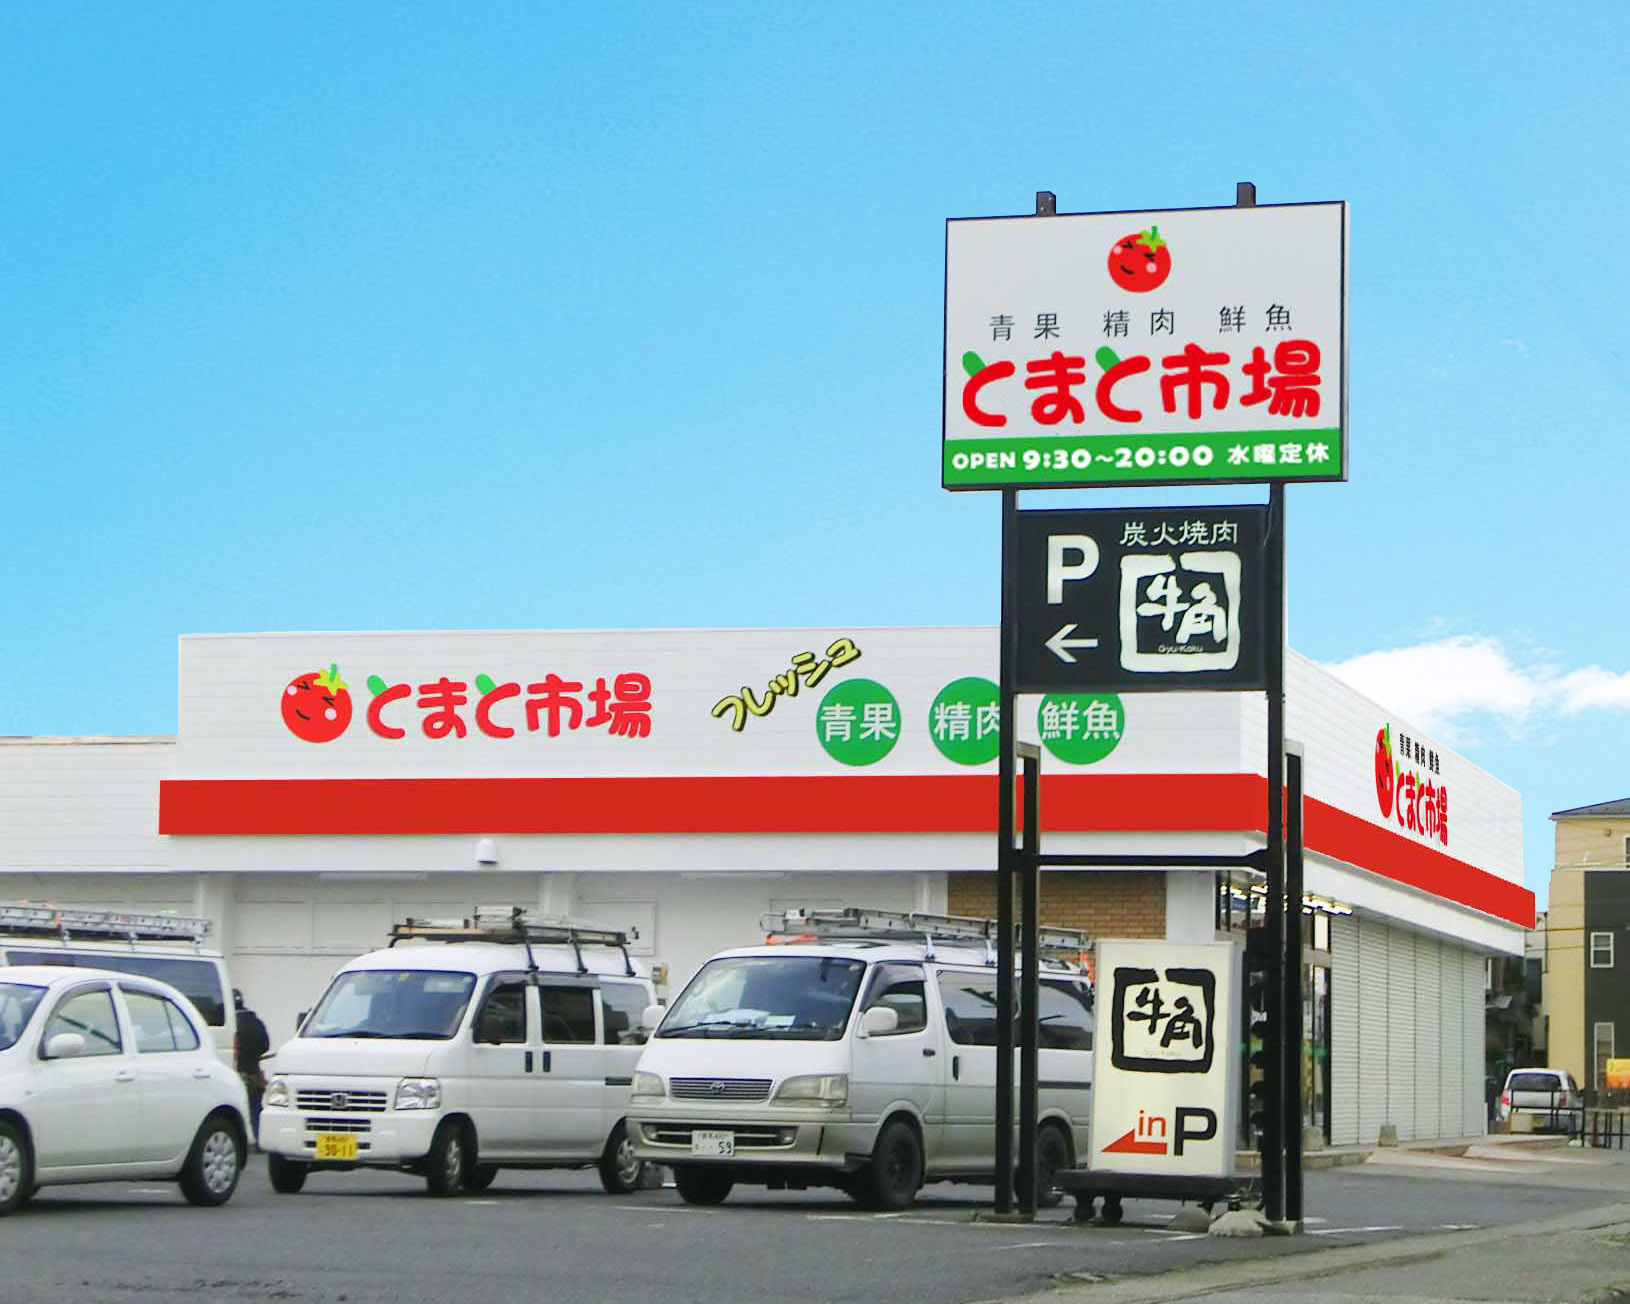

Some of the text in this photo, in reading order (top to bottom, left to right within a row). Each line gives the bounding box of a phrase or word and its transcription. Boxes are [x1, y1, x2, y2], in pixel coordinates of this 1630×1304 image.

[988, 304, 1293, 342] 青果 精肉 鮮魚
[962, 339, 1321, 427] とまと市場
[952, 450, 1016, 470] OPEN
[1227, 442, 1330, 466] 水曜定休
[1119, 520, 1238, 546] 炭火焼肉
[1047, 534, 1100, 604] P
[1136, 575, 1228, 644] 牛角
[366, 672, 653, 741] とまと市場
[711, 637, 863, 732] フレッシュ
[819, 701, 897, 742] 青果
[1041, 700, 1121, 741] 鮮魚
[1395, 760, 1448, 847] とまと市場
[1127, 987, 1204, 1049] 牛角
[1137, 1106, 1218, 1156] in P
